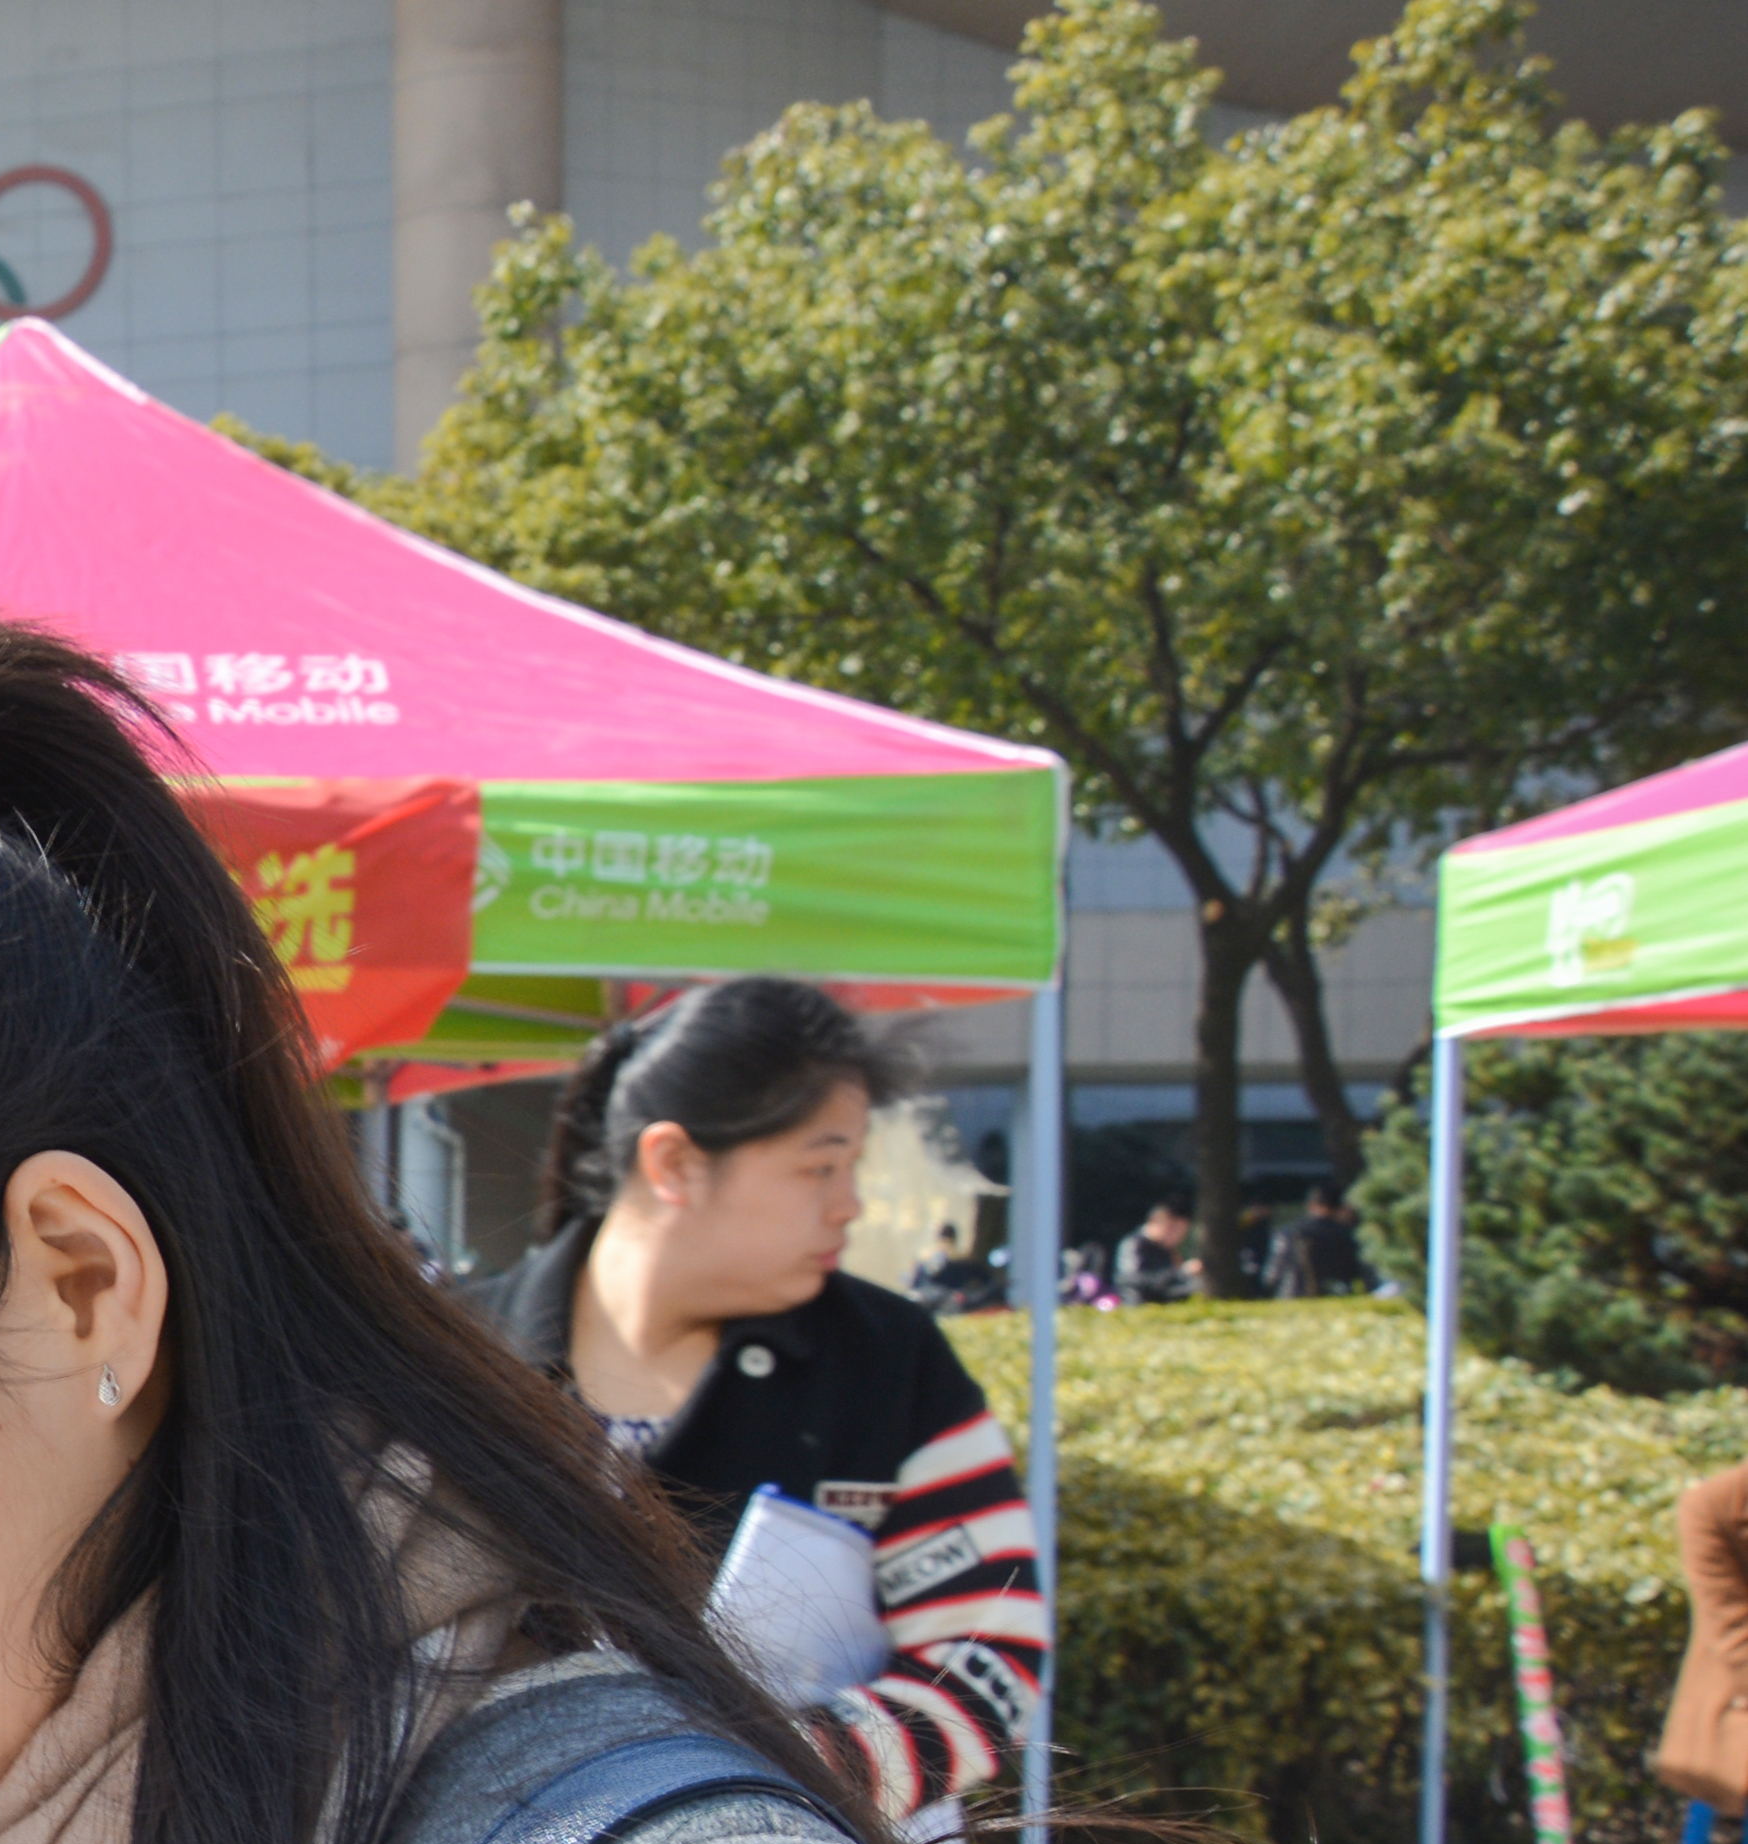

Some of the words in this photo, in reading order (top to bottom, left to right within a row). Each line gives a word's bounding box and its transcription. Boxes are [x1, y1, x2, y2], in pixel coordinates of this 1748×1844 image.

[207, 696, 400, 725] Mobile
[531, 829, 772, 888] 中国移动
[530, 884, 639, 922] China
[646, 888, 770, 927] Mobile
